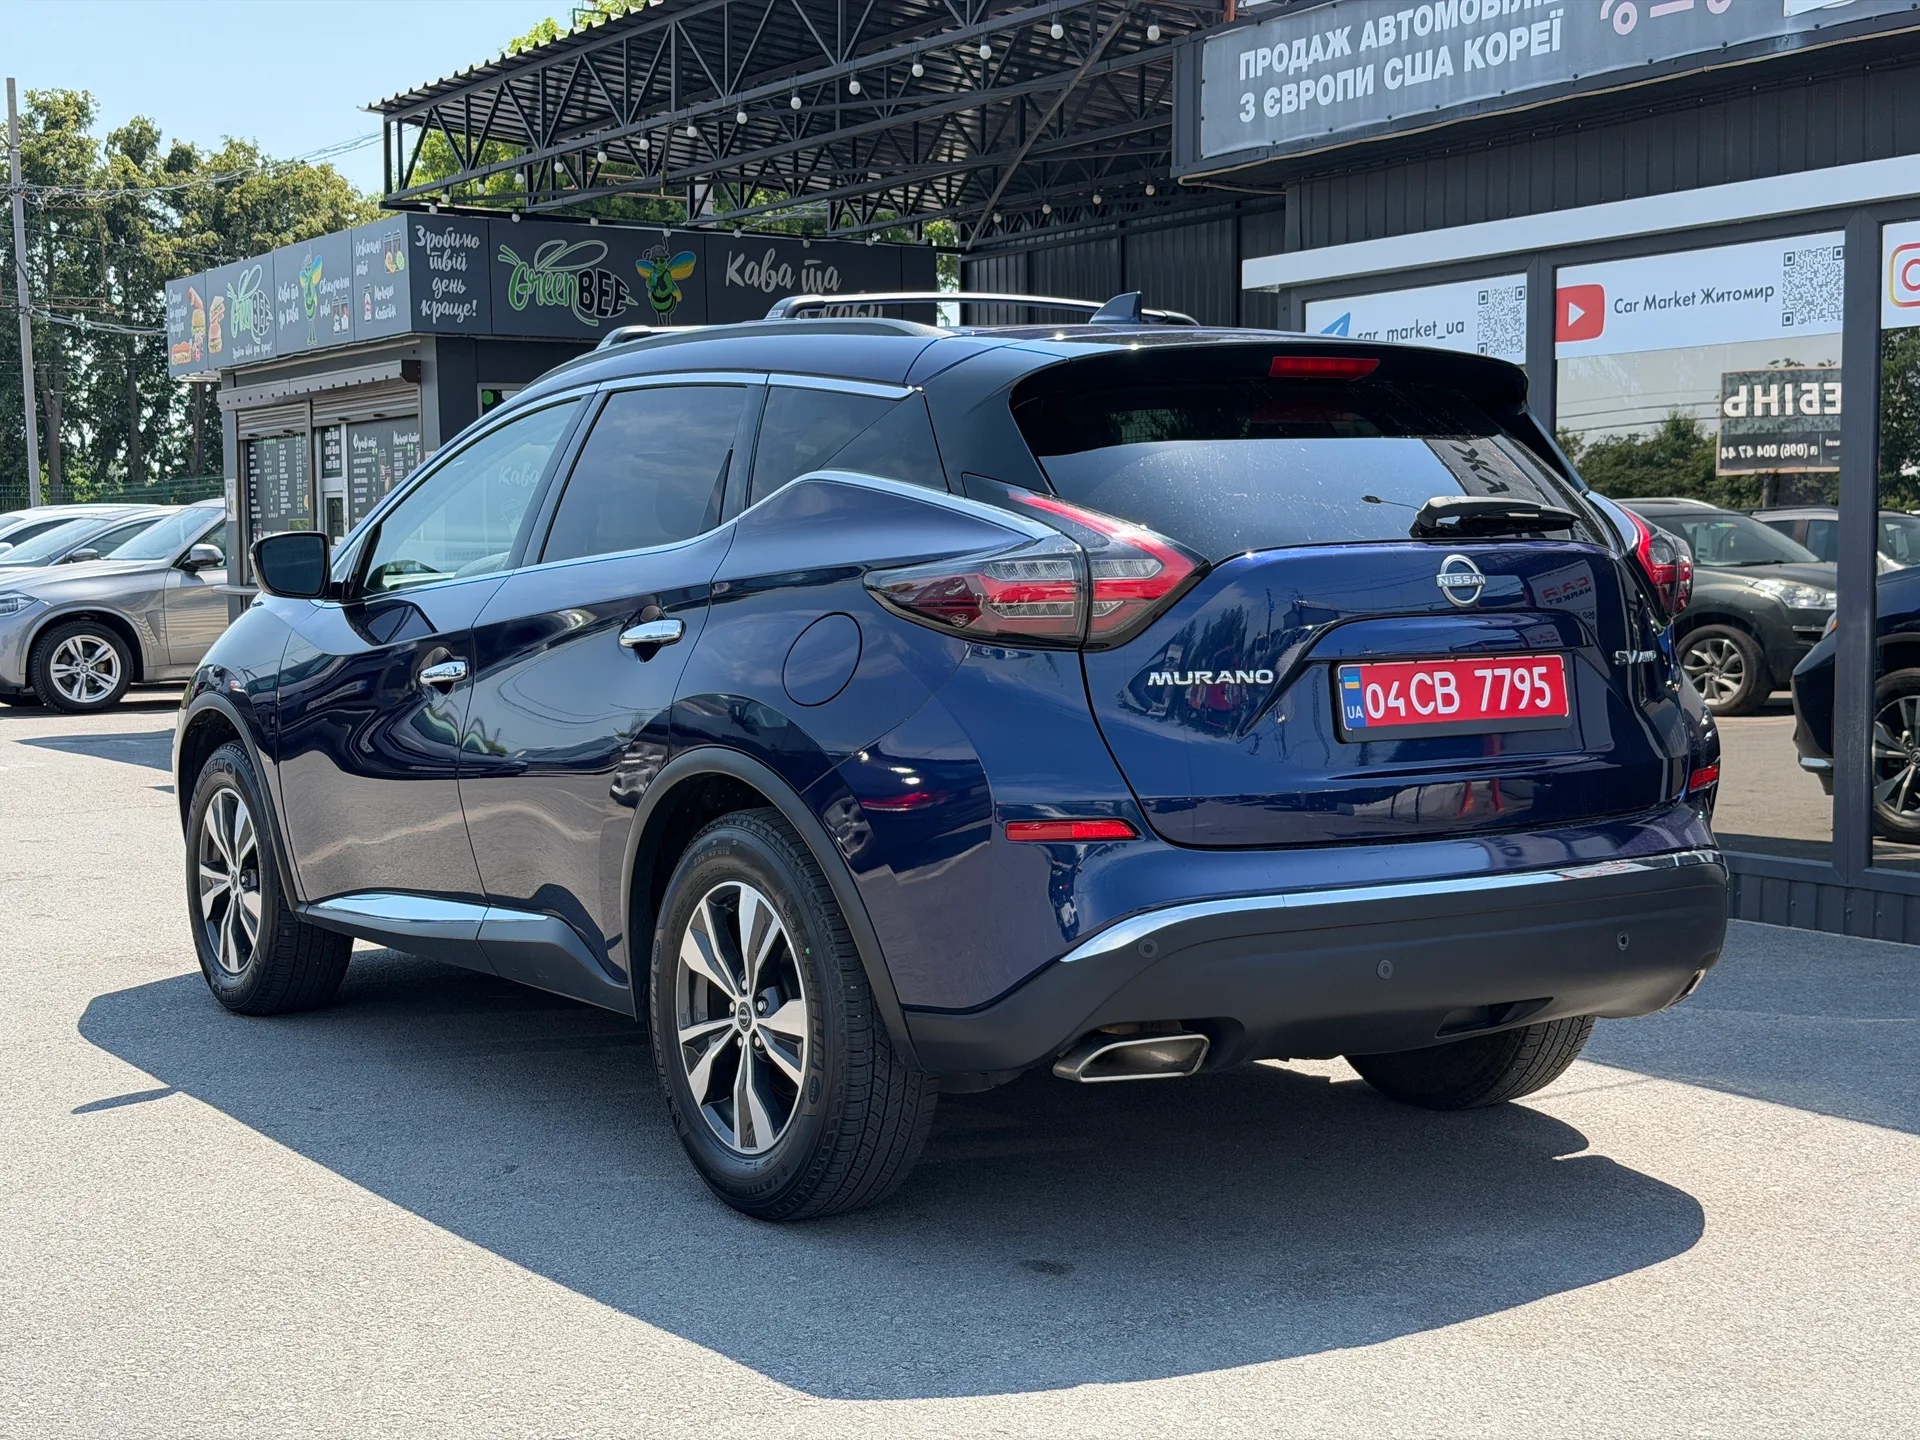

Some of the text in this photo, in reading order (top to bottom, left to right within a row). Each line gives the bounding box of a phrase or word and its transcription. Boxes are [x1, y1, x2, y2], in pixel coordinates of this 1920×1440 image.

[1239, 0, 1558, 81] ПРОДАЖ АВТОМОБ
[1239, 9, 1564, 123] З ЄВРОПИ США КОРЕЇ
[415, 225, 480, 255] Зробимо
[429, 248, 468, 272] твій
[726, 248, 842, 294] Кава та
[432, 277, 467, 299] день
[1614, 284, 1775, 314] Car Market Житомир
[420, 299, 478, 325] краще!
[1438, 574, 1486, 586] NISSAN
[1147, 669, 1274, 686] MURANO
[1474, 666, 1551, 712] 7795
[1347, 707, 1364, 719] UA
